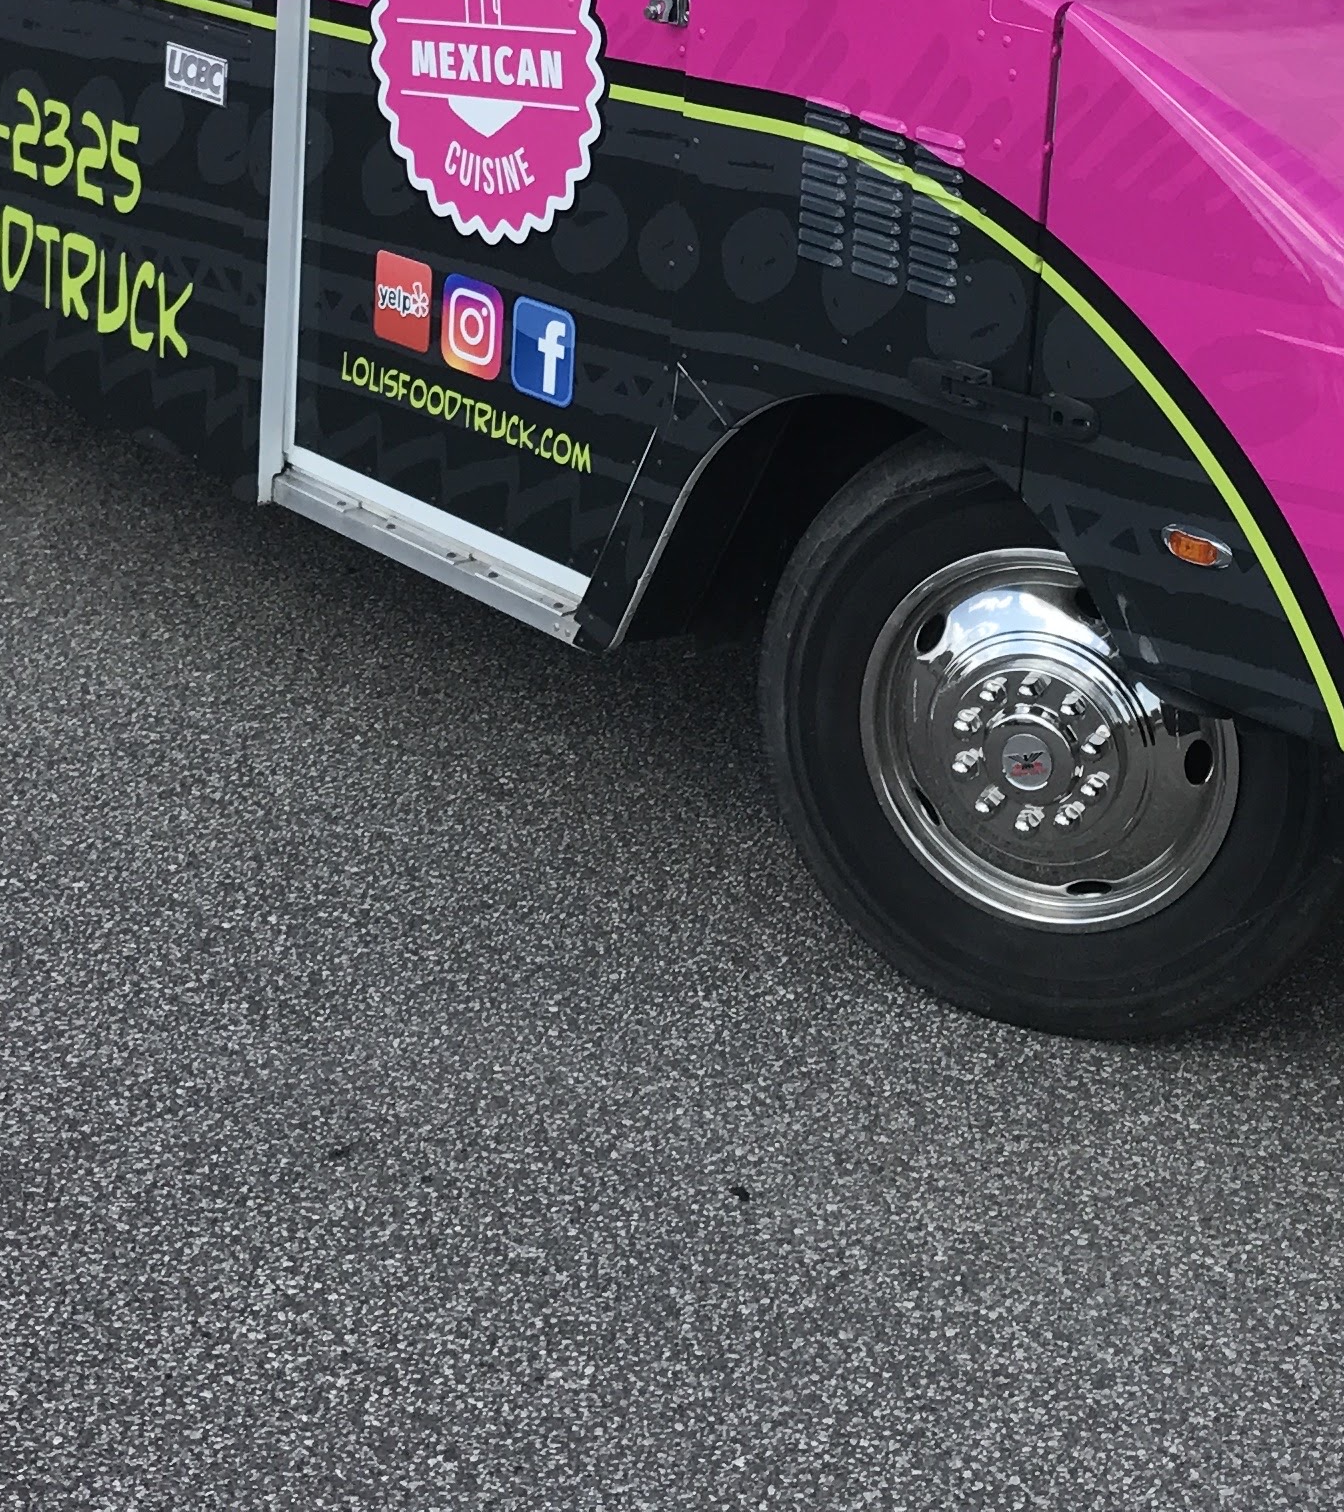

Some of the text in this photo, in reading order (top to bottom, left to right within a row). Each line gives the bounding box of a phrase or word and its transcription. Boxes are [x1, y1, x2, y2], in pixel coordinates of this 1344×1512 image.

[410, 39, 564, 90] MEXICAN
[444, 140, 536, 195] CUISINE
[377, 284, 413, 317] yelp
[340, 351, 592, 474] LOLISFOODTRUCK.COM
